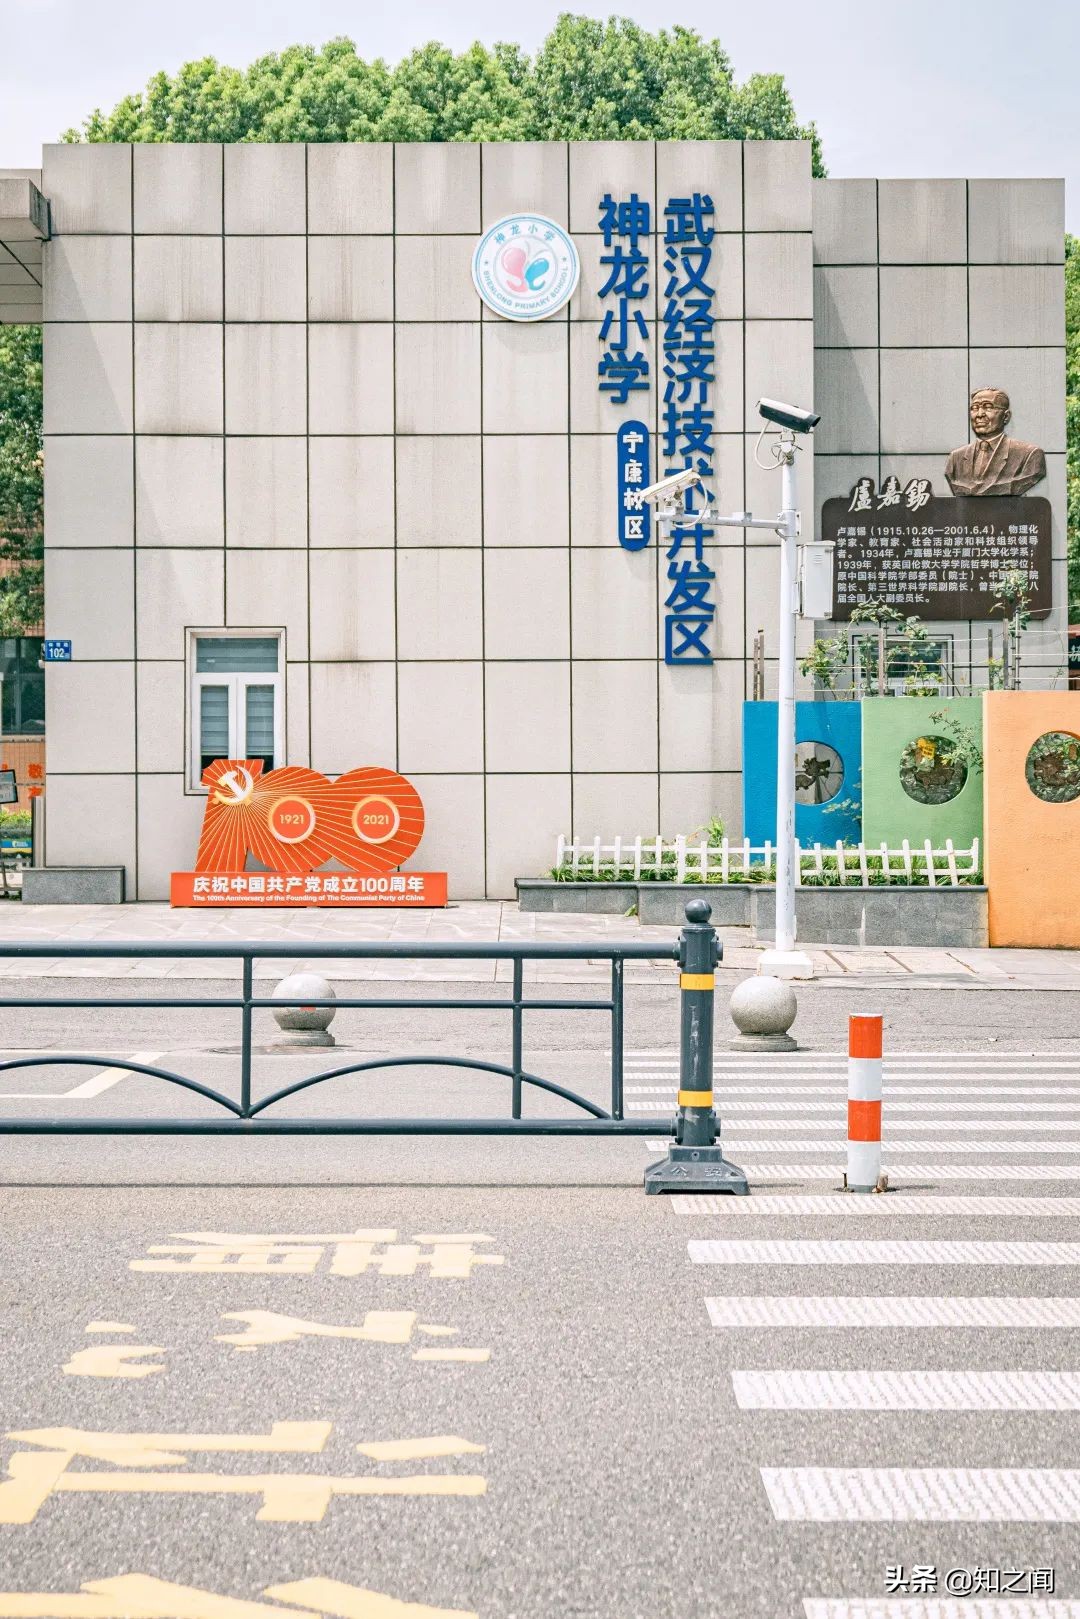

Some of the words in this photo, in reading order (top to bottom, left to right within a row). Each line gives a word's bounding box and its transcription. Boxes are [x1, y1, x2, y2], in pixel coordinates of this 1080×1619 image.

[483, 270, 513, 307] SHENLONG
[515, 295, 550, 310] PRIMARY
[550, 266, 570, 299] SCHOOL
[599, 193, 650, 403] 神龙小学
[663, 193, 716, 665] 武汉经济技术开发区
[622, 431, 644, 540] 宁康校区
[49, 647, 65, 658] 102
[280, 814, 305, 825] 1921
[363, 814, 390, 825] 2021
[193, 876, 425, 893] 庆祝中国共产党成立100周年
[225, 894, 265, 902] Anniversary
[286, 894, 317, 902] Founding
[379, 894, 396, 902] Party
